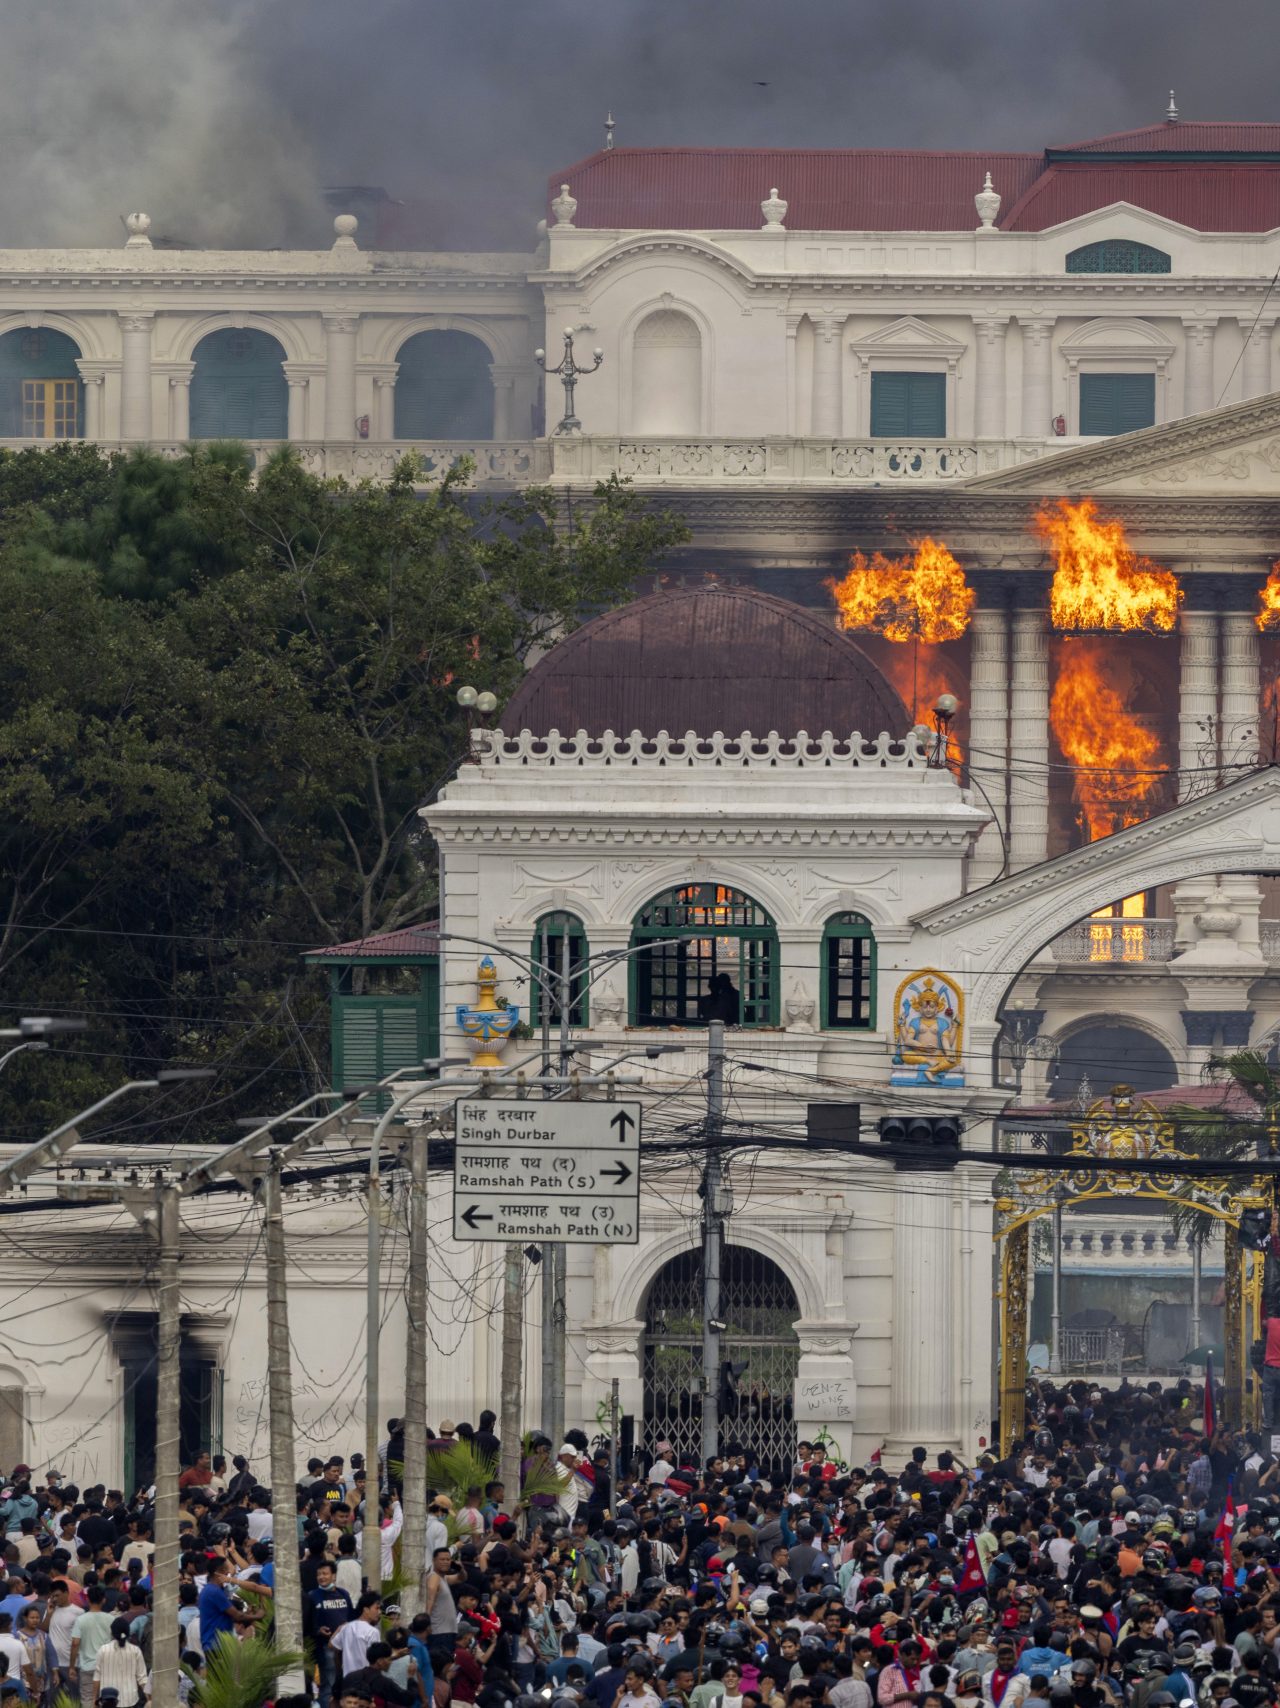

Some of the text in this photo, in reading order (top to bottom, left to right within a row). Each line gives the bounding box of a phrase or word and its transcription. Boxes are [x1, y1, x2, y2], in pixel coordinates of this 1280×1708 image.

[462, 1105, 536, 1121] सिंह दरबार
[461, 1127, 556, 1140] Singh Durbar
[461, 1156, 576, 1172] रामशाह पथ (द)
[460, 1175, 595, 1189] Ramshah Path (S)
[499, 1205, 615, 1220] रामशाह पथ (उ)
[497, 1223, 632, 1237] Ramshah Path (N)
